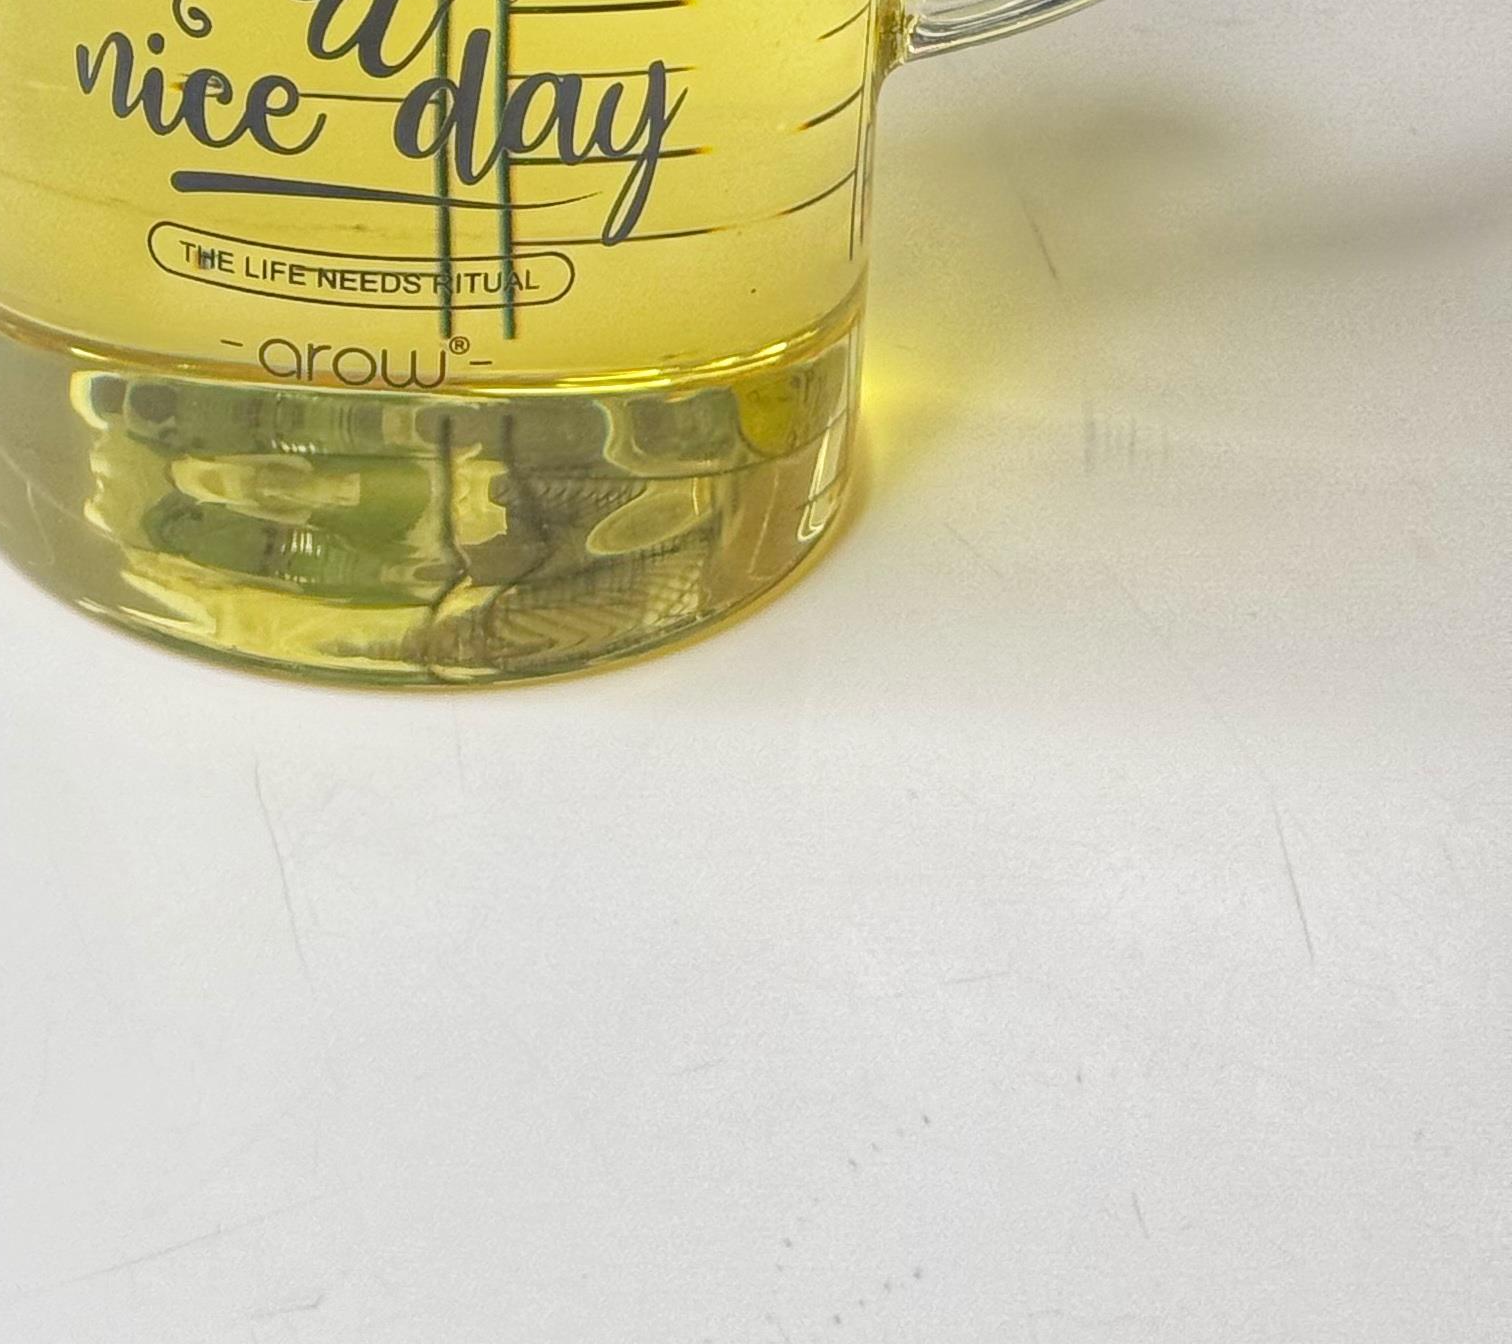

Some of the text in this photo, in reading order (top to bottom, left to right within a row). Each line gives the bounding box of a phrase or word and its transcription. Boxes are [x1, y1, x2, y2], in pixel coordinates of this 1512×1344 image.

[75, 29, 688, 245] nice day
[179, 239, 540, 296] THE LIFE NEEDS RITUAL
